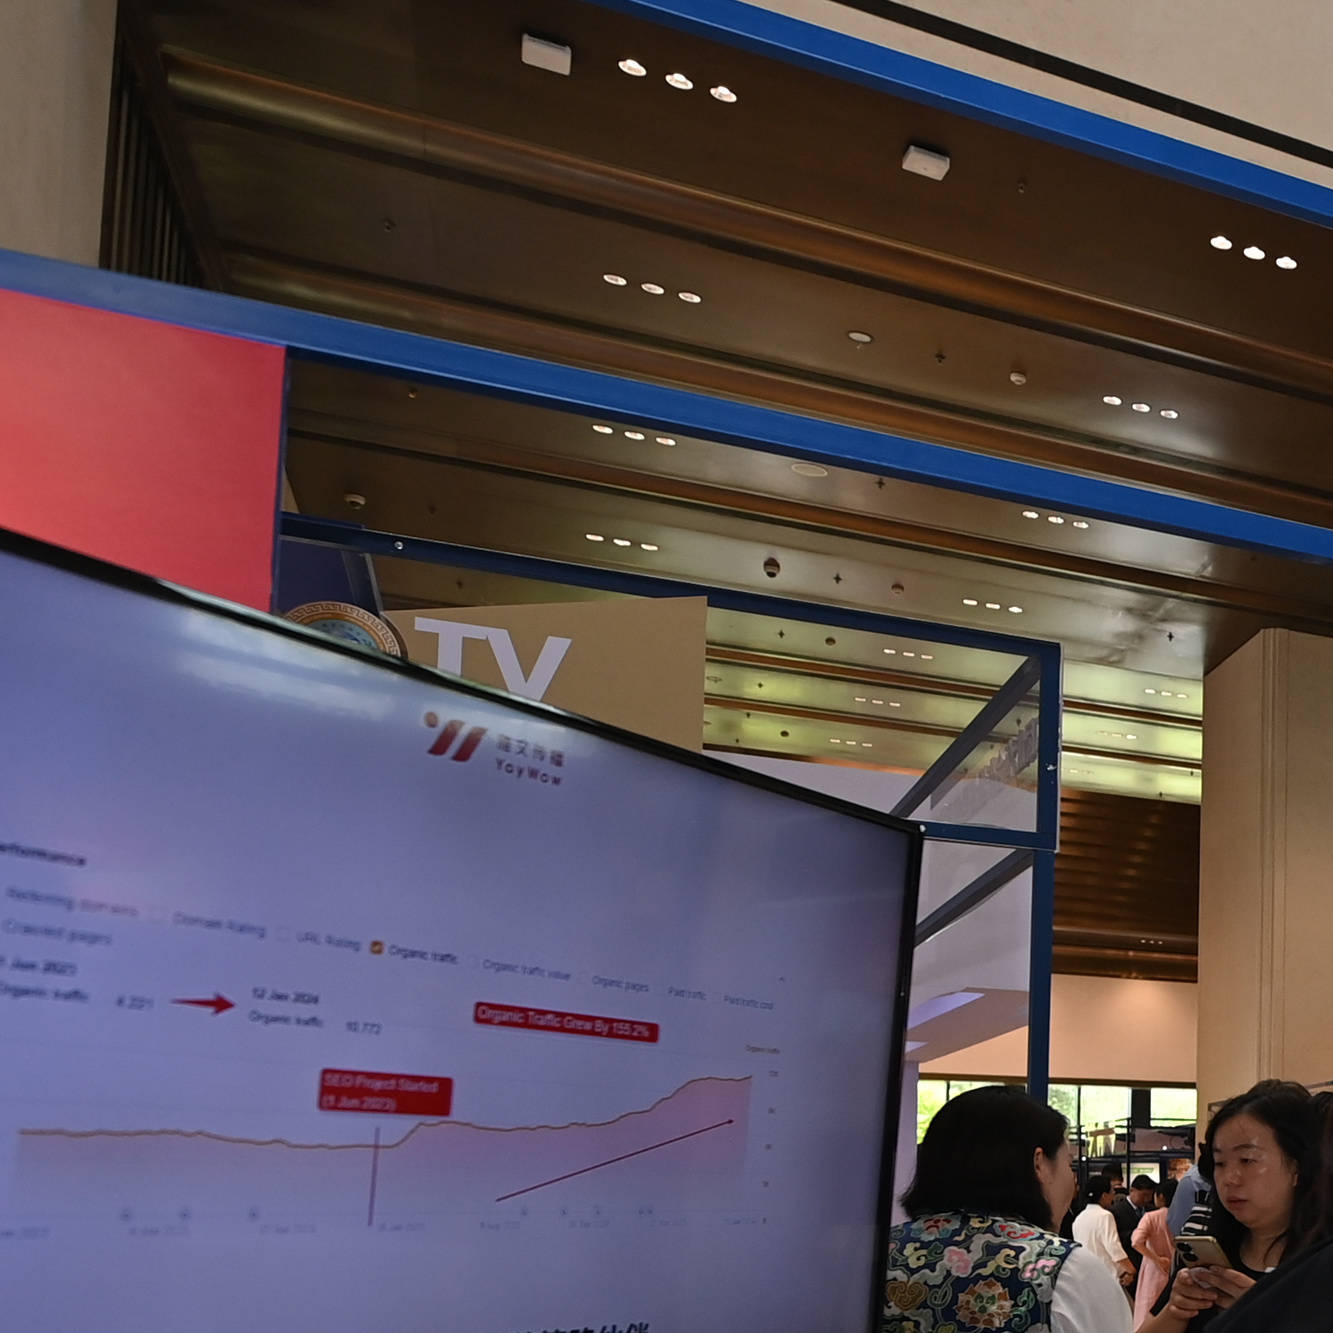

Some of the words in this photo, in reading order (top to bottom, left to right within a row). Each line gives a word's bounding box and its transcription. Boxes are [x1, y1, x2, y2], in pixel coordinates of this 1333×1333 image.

[414, 616, 573, 702] TV
[477, 1006, 524, 1025] Organic
[527, 1011, 561, 1029] Traffic
[563, 1015, 593, 1031] Grew
[595, 1019, 609, 1036] By
